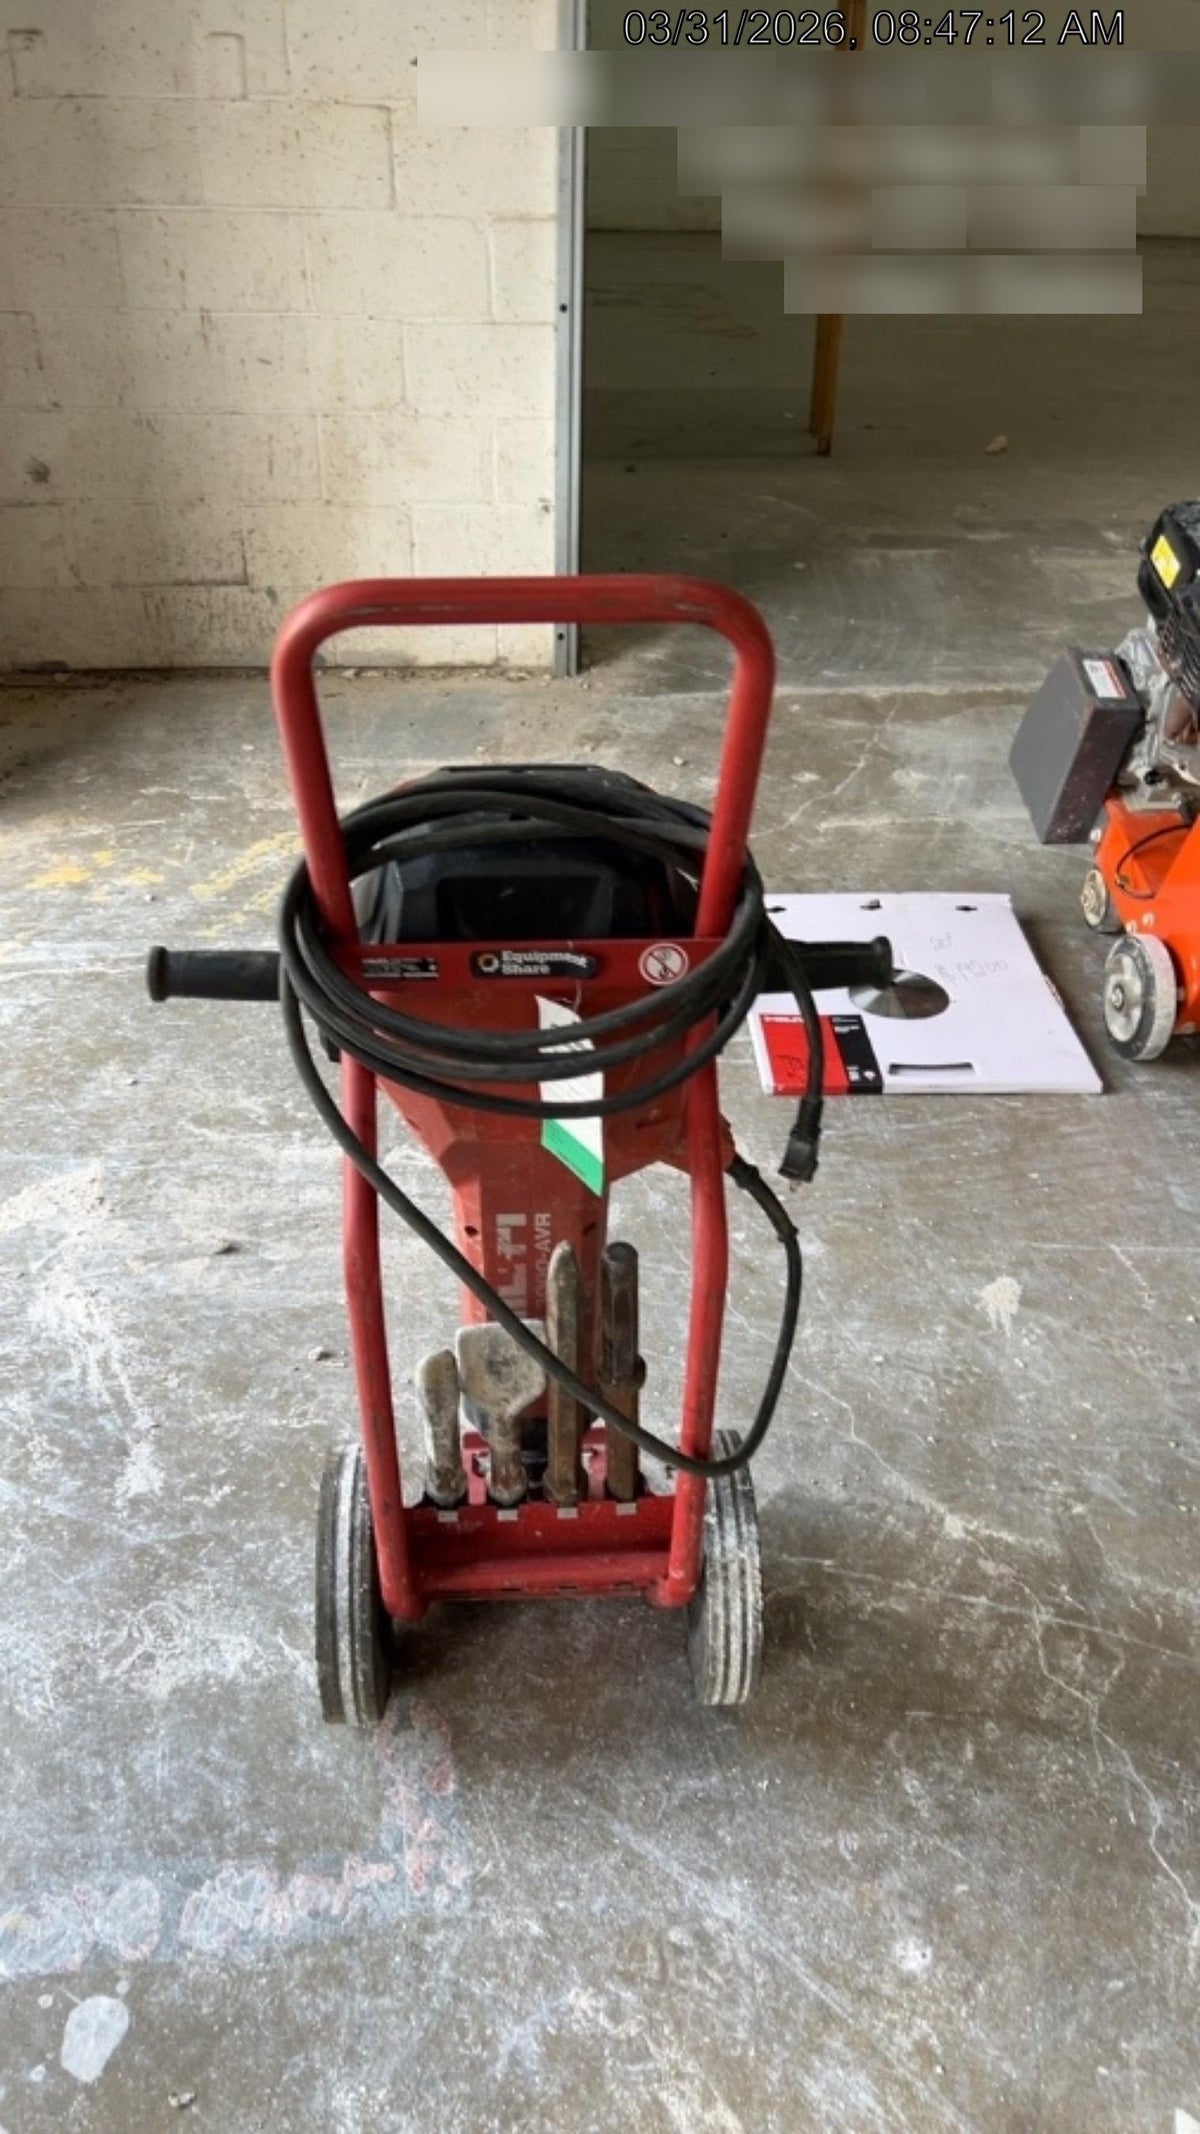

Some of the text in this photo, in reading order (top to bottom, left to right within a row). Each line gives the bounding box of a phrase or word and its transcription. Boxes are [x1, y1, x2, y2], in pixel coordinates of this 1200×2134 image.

[501, 950, 587, 968] Equipment
[501, 963, 551, 976] Share
[496, 1213, 527, 1318] ILTI
